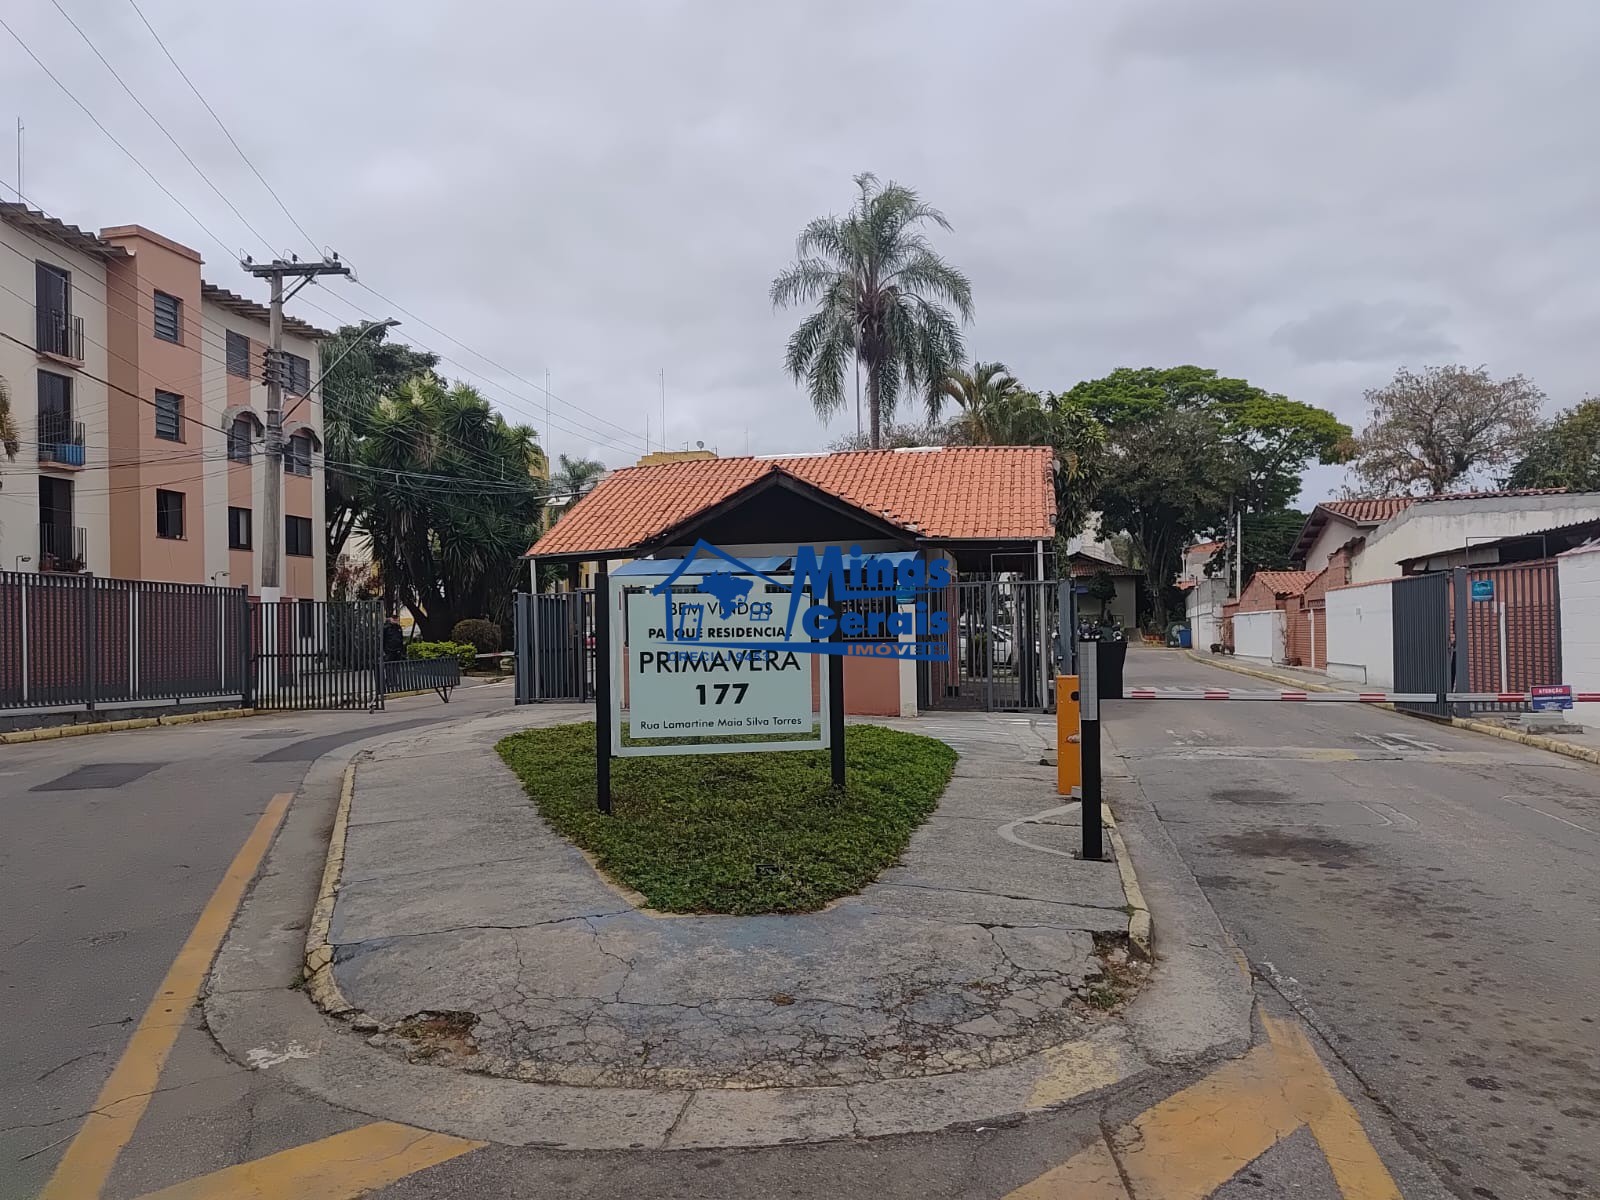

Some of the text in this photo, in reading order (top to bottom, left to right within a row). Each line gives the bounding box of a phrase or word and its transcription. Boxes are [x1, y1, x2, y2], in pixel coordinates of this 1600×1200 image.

[648, 627, 792, 638] PAQUE RESIDENCIA
[639, 650, 801, 673] PRIMAVERA
[695, 683, 749, 705] 177
[640, 716, 802, 730] Rua Lamartine Maia Silva Torres
